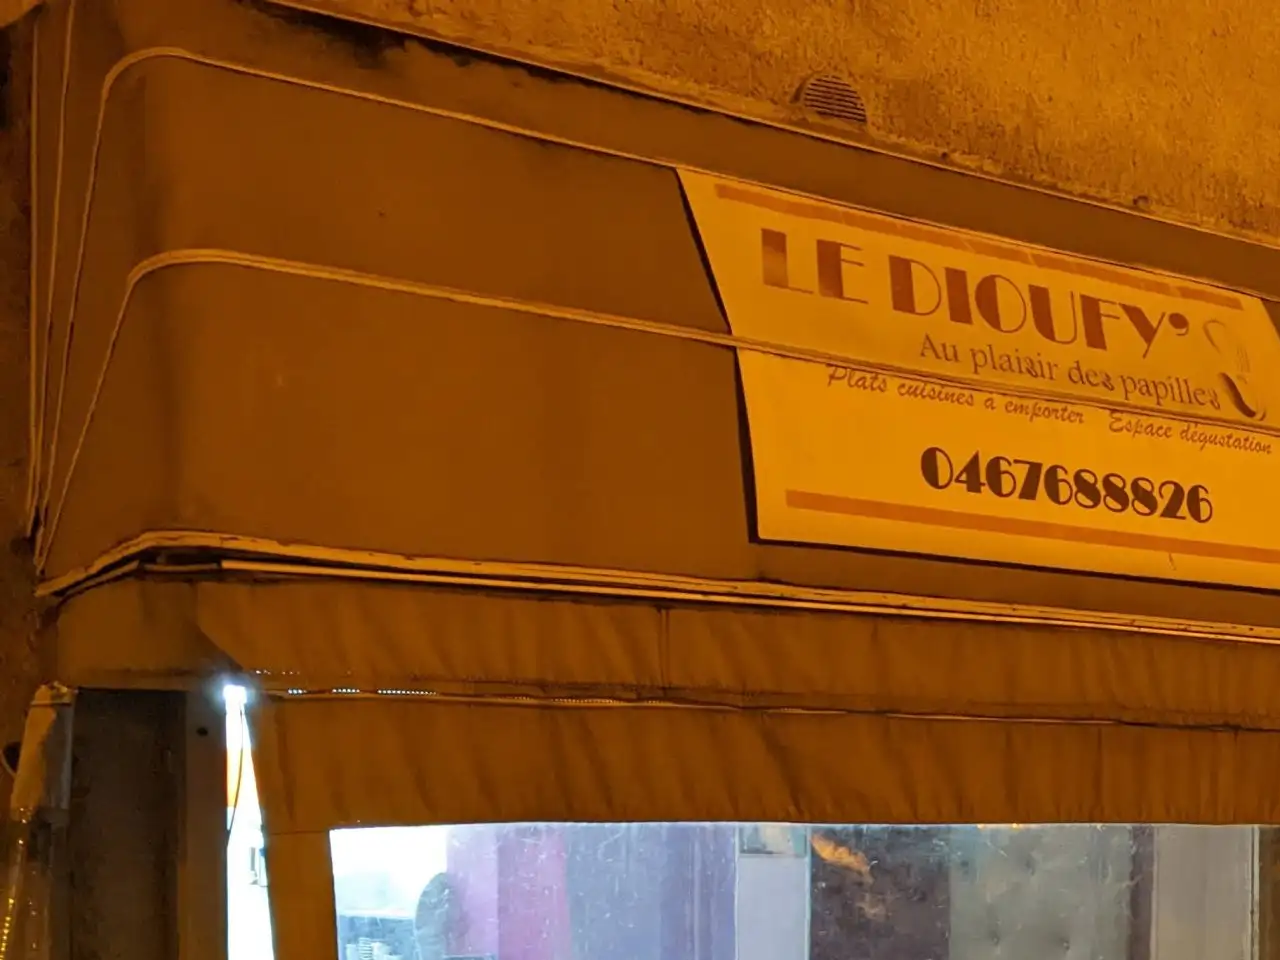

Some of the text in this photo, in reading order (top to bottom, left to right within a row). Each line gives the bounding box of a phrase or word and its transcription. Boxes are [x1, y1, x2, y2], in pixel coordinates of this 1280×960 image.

[760, 227, 869, 305] LE
[825, 363, 888, 394] Plats
[1004, 398, 1085, 425] emporter
[1108, 410, 1173, 440] Espace
[919, 332, 1221, 411] Au plaisir des papilles
[920, 446, 1214, 524] 0467688826
